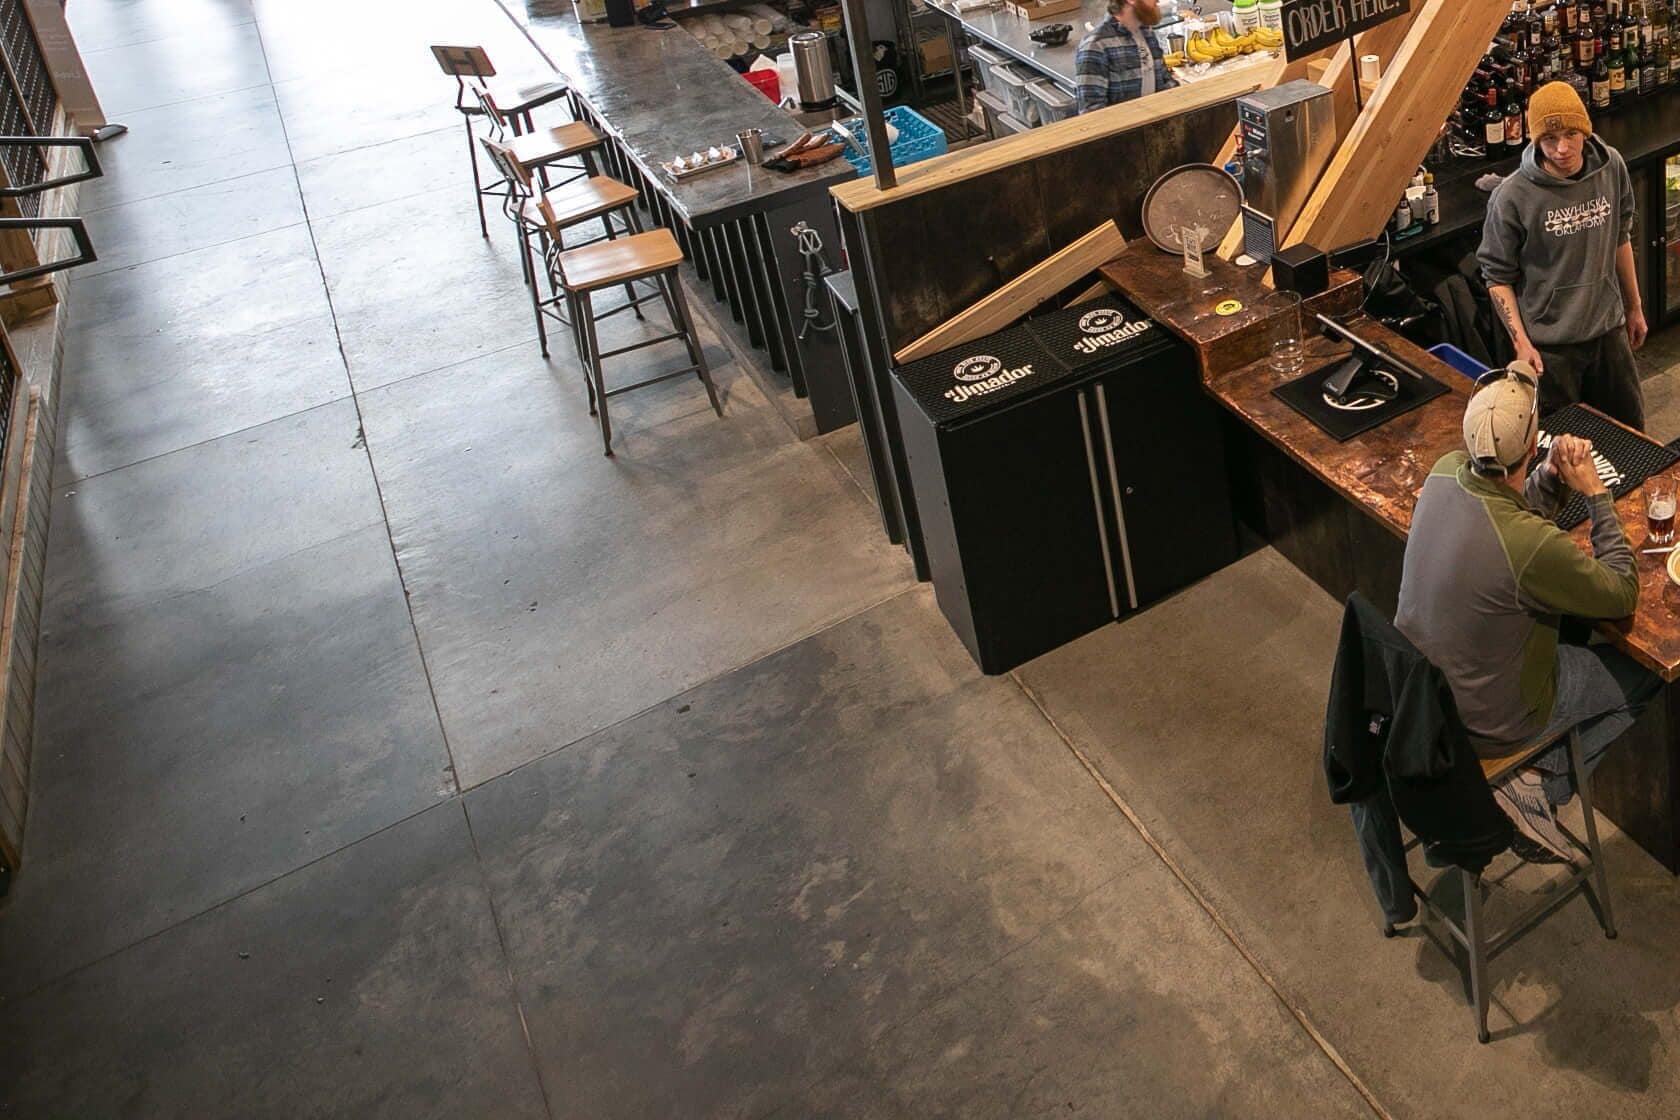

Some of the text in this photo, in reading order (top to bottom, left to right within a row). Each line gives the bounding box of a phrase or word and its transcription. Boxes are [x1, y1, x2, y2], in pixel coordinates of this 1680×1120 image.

[1546, 195, 1609, 221] PAWHUSKA
[1554, 214, 1607, 237] OKLAHOMA
[952, 363, 1034, 403] Jimador
